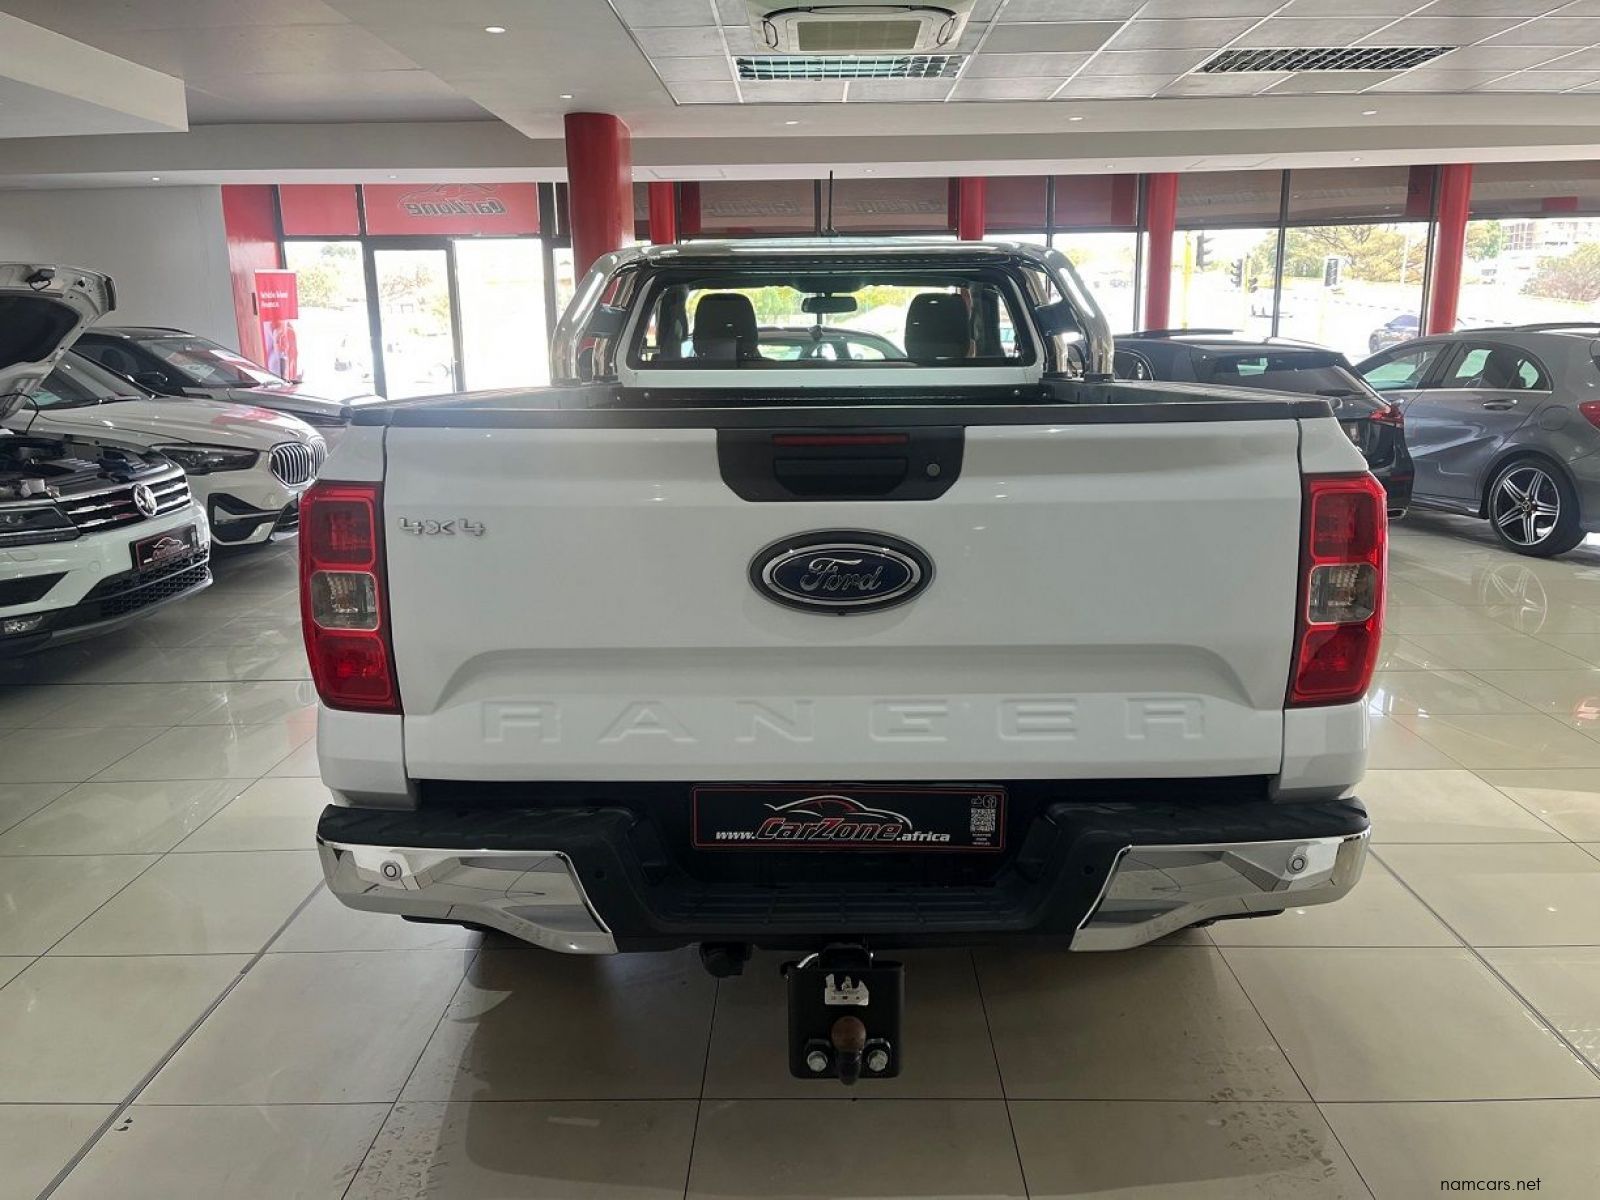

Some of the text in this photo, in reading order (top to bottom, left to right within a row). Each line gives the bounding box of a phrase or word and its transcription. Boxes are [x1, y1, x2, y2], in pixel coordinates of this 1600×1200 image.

[399, 517, 486, 537] 4X4
[800, 557, 884, 592] Ford
[481, 698, 1205, 742] RANGER
